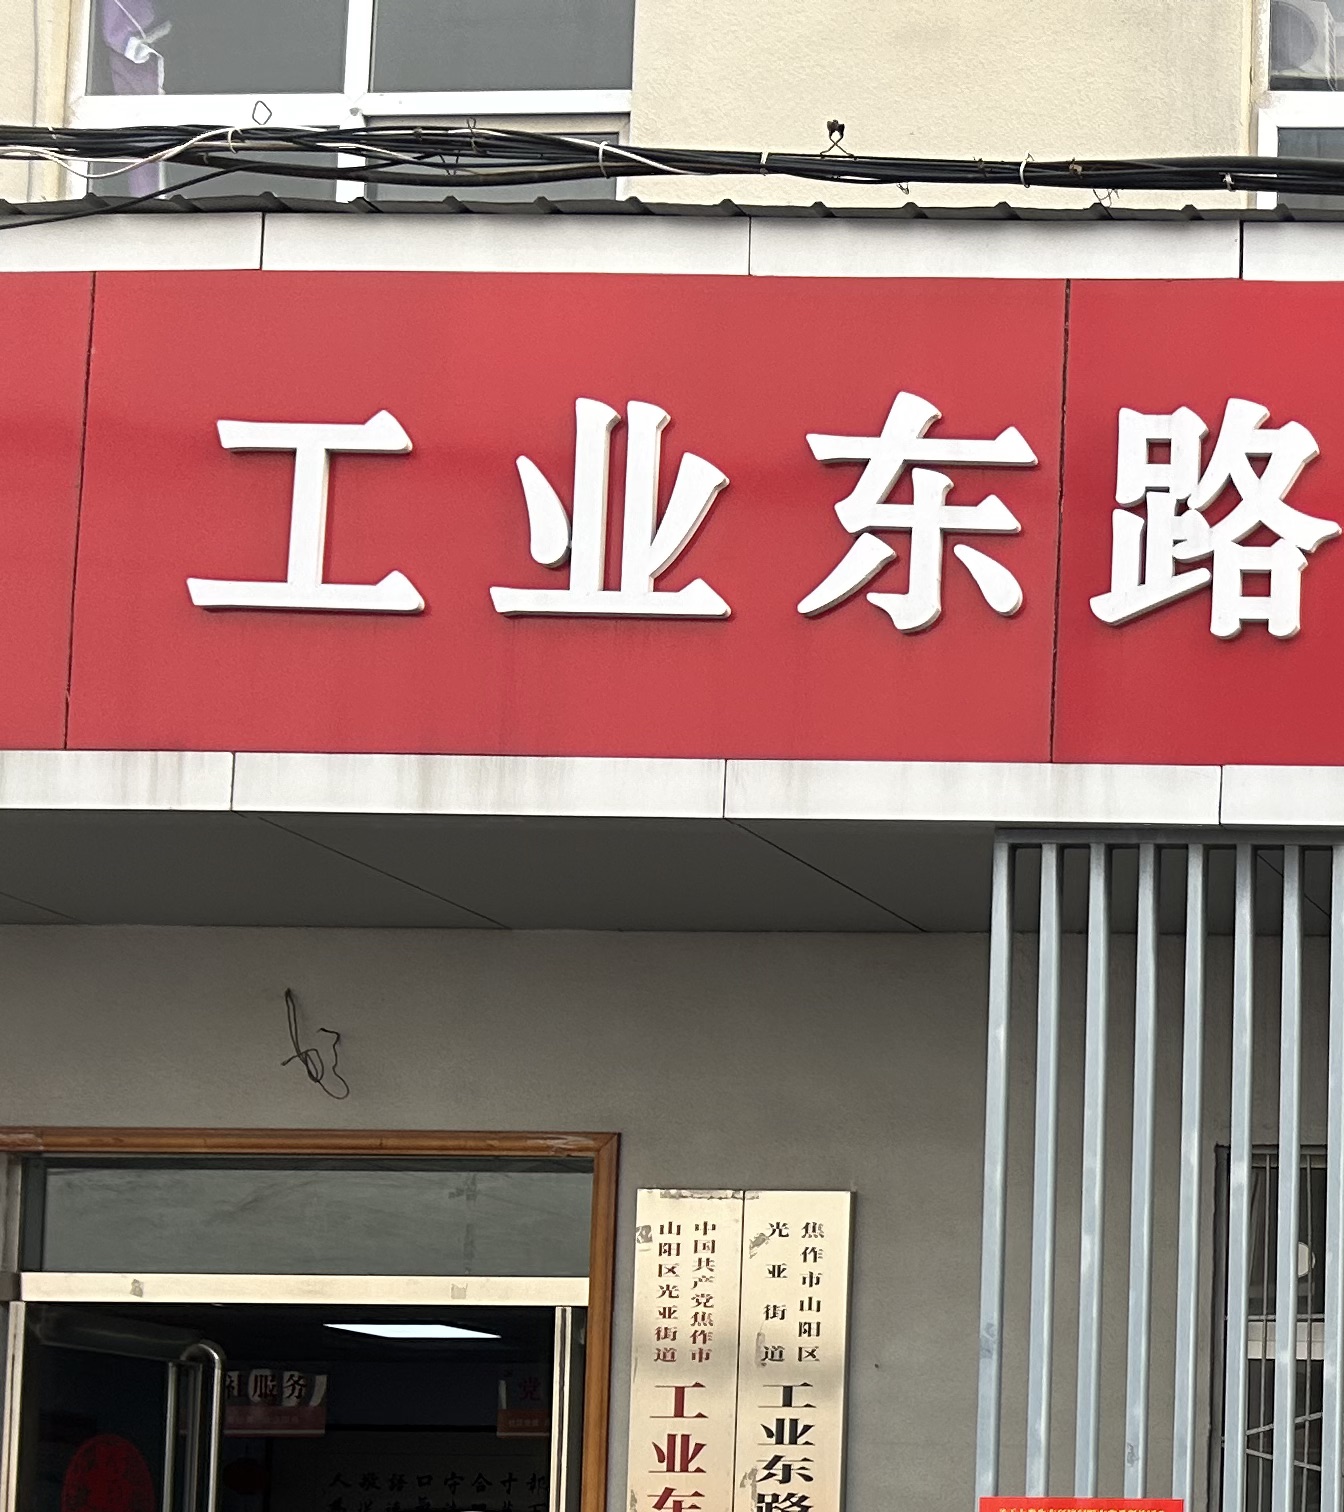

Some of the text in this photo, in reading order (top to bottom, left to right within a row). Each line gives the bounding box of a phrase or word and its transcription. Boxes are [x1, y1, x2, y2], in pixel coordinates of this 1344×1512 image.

[653, 1221, 682, 1363] 山阳区光亚街道
[689, 1220, 717, 1363] 中国共产党焦作市
[760, 1221, 791, 1362] 光亚街道
[797, 1221, 826, 1362] 焦作市山阳区
